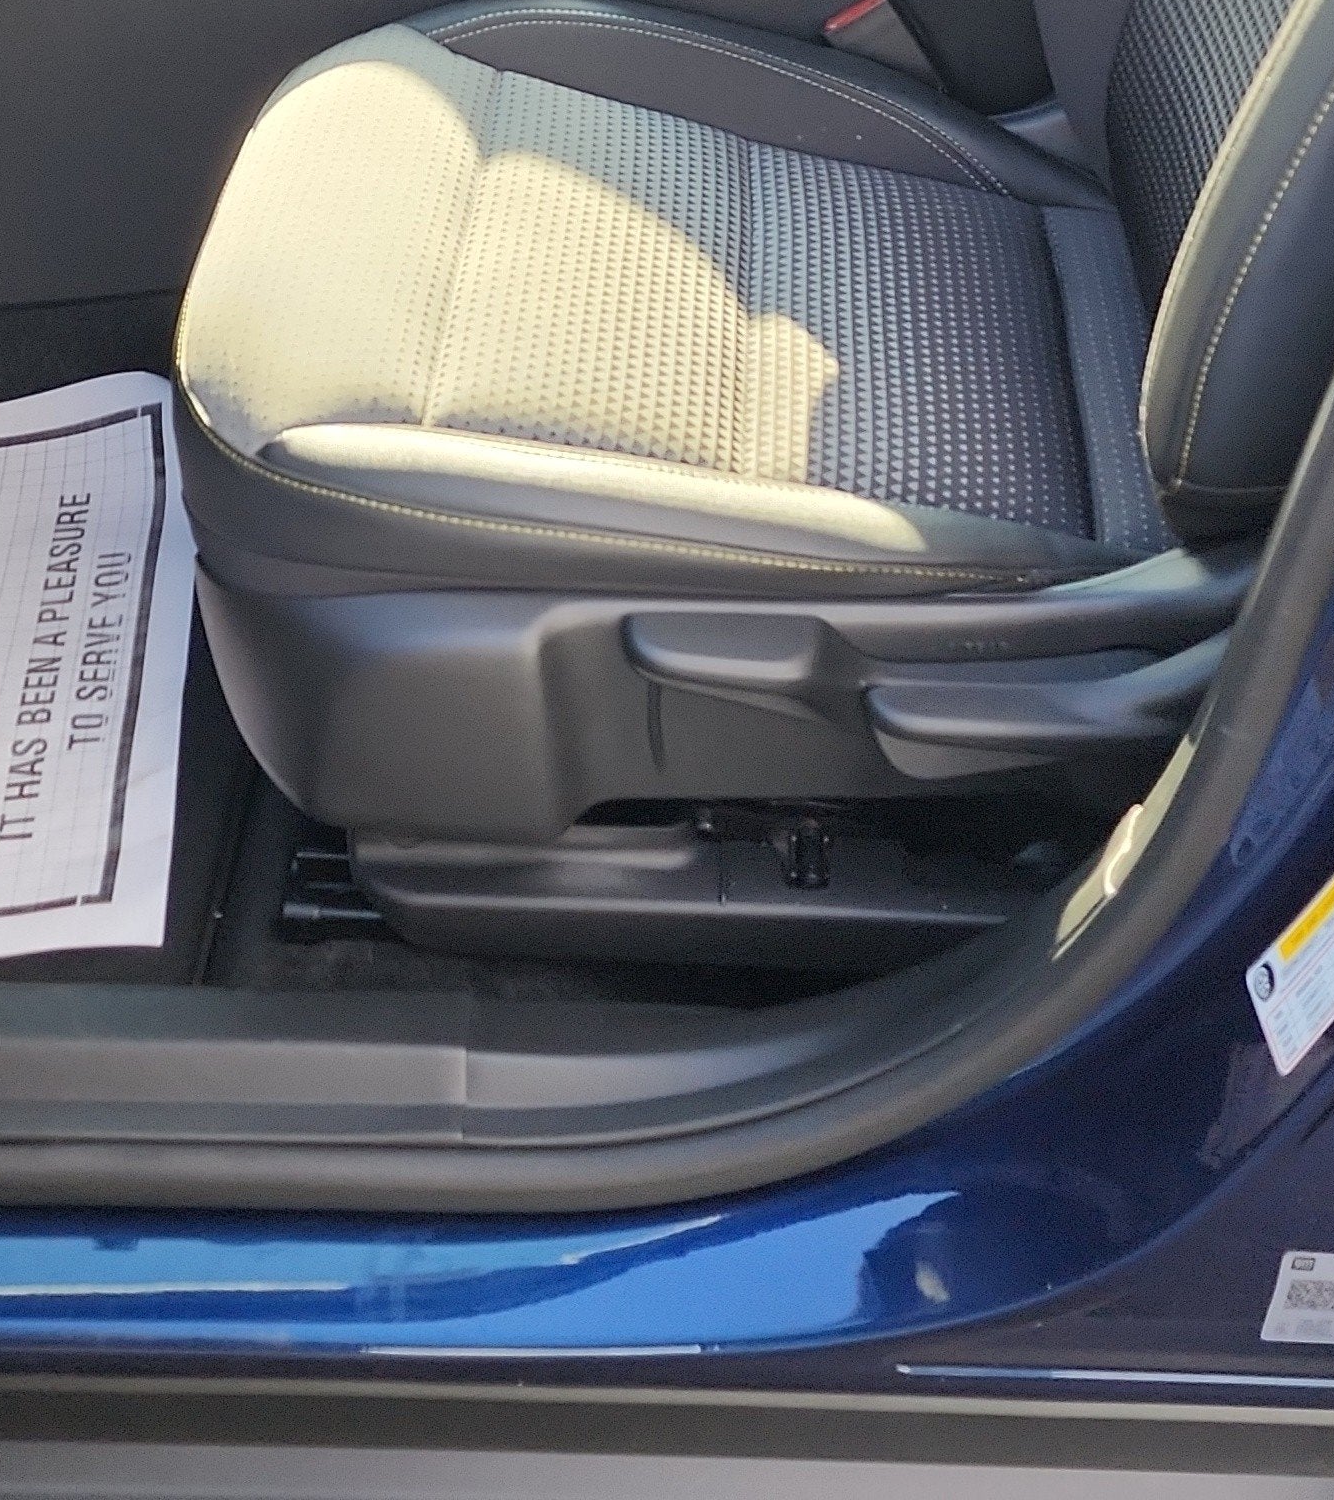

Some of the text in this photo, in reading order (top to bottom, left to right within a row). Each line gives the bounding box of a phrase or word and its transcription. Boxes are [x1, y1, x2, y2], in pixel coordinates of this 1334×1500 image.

[38, 492, 91, 624] PLEASURE
[33, 630, 67, 648] A
[68, 551, 130, 750] TO SERVE YOU
[17, 656, 62, 727] BEEN
[4, 737, 48, 802] HAS
